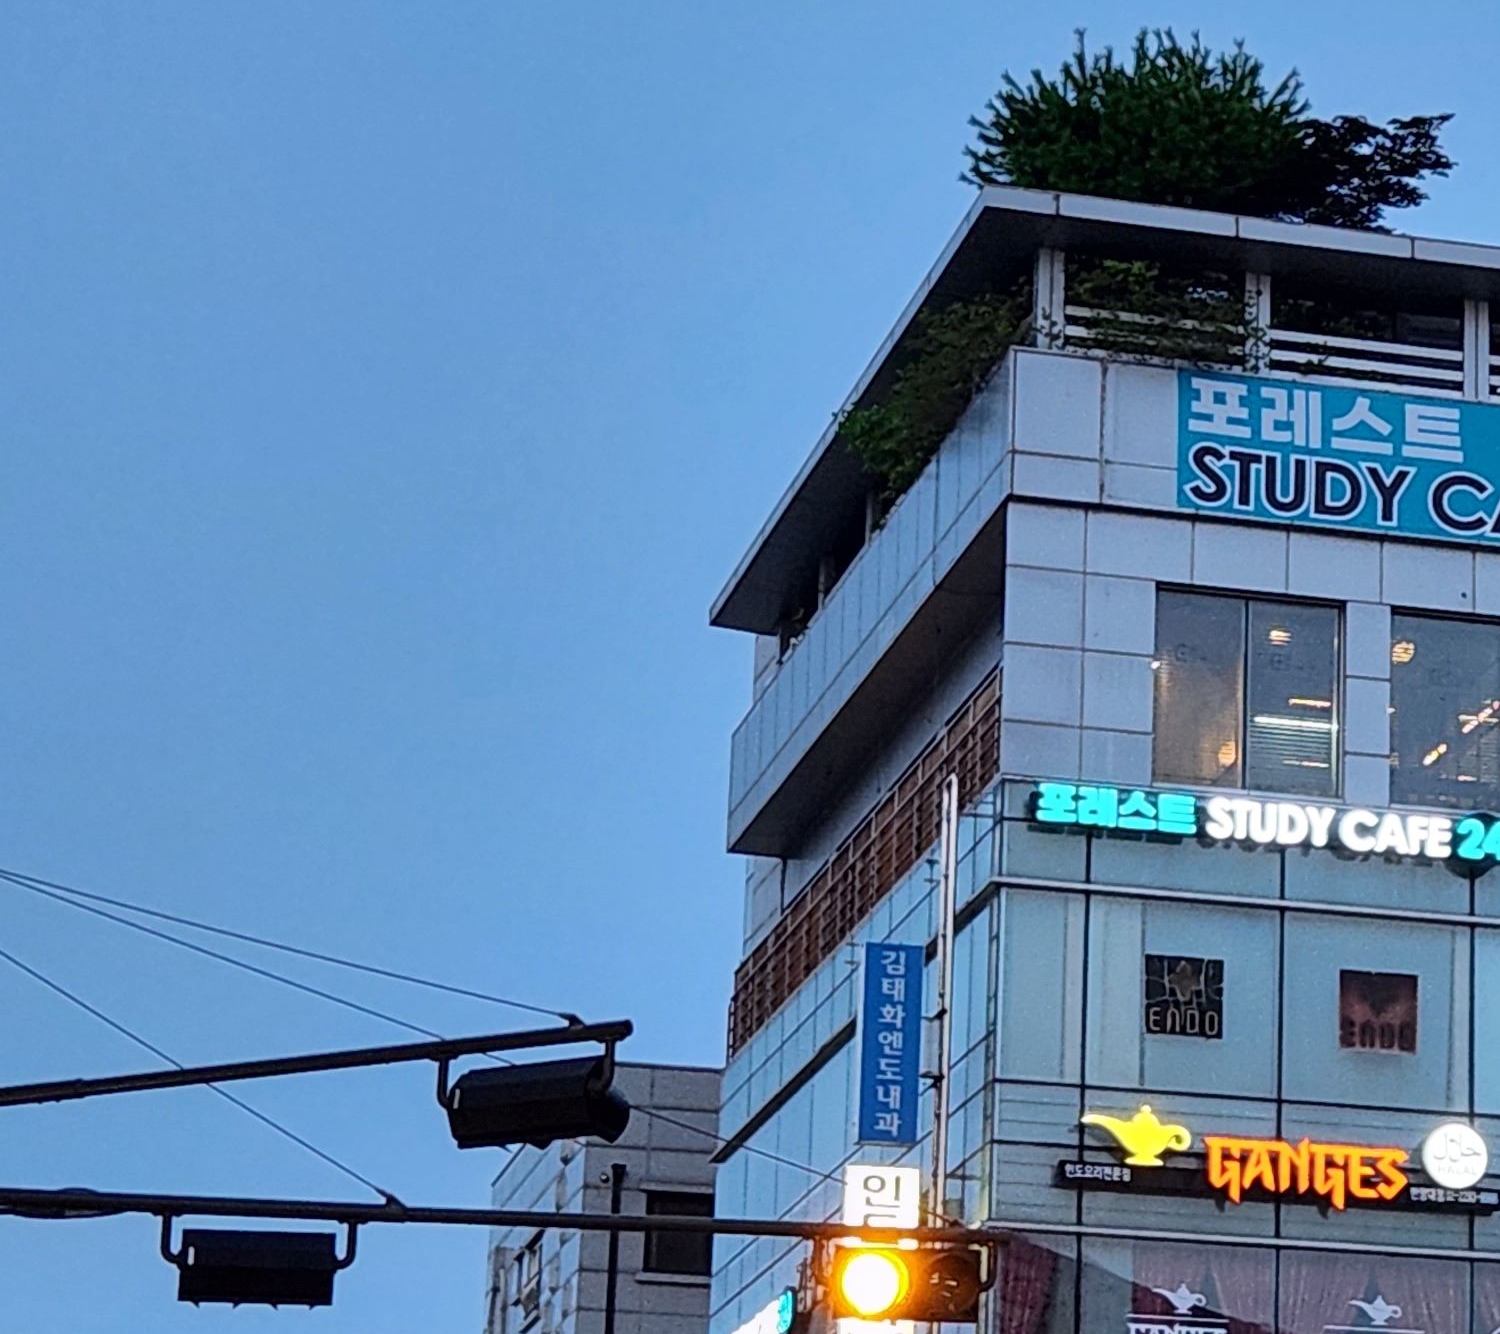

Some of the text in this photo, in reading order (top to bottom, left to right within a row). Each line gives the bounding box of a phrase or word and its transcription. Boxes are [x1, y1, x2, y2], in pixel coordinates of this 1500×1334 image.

[1186, 375, 1464, 465] 포레스트
[1184, 443, 1411, 527] STUDY
[1034, 782, 1197, 836] 포레스트
[1204, 794, 1337, 854] STUDY
[1338, 807, 1452, 860] CAFE
[872, 949, 907, 1139] 김태화엔도내과
[1204, 1137, 1411, 1211] GANGES
